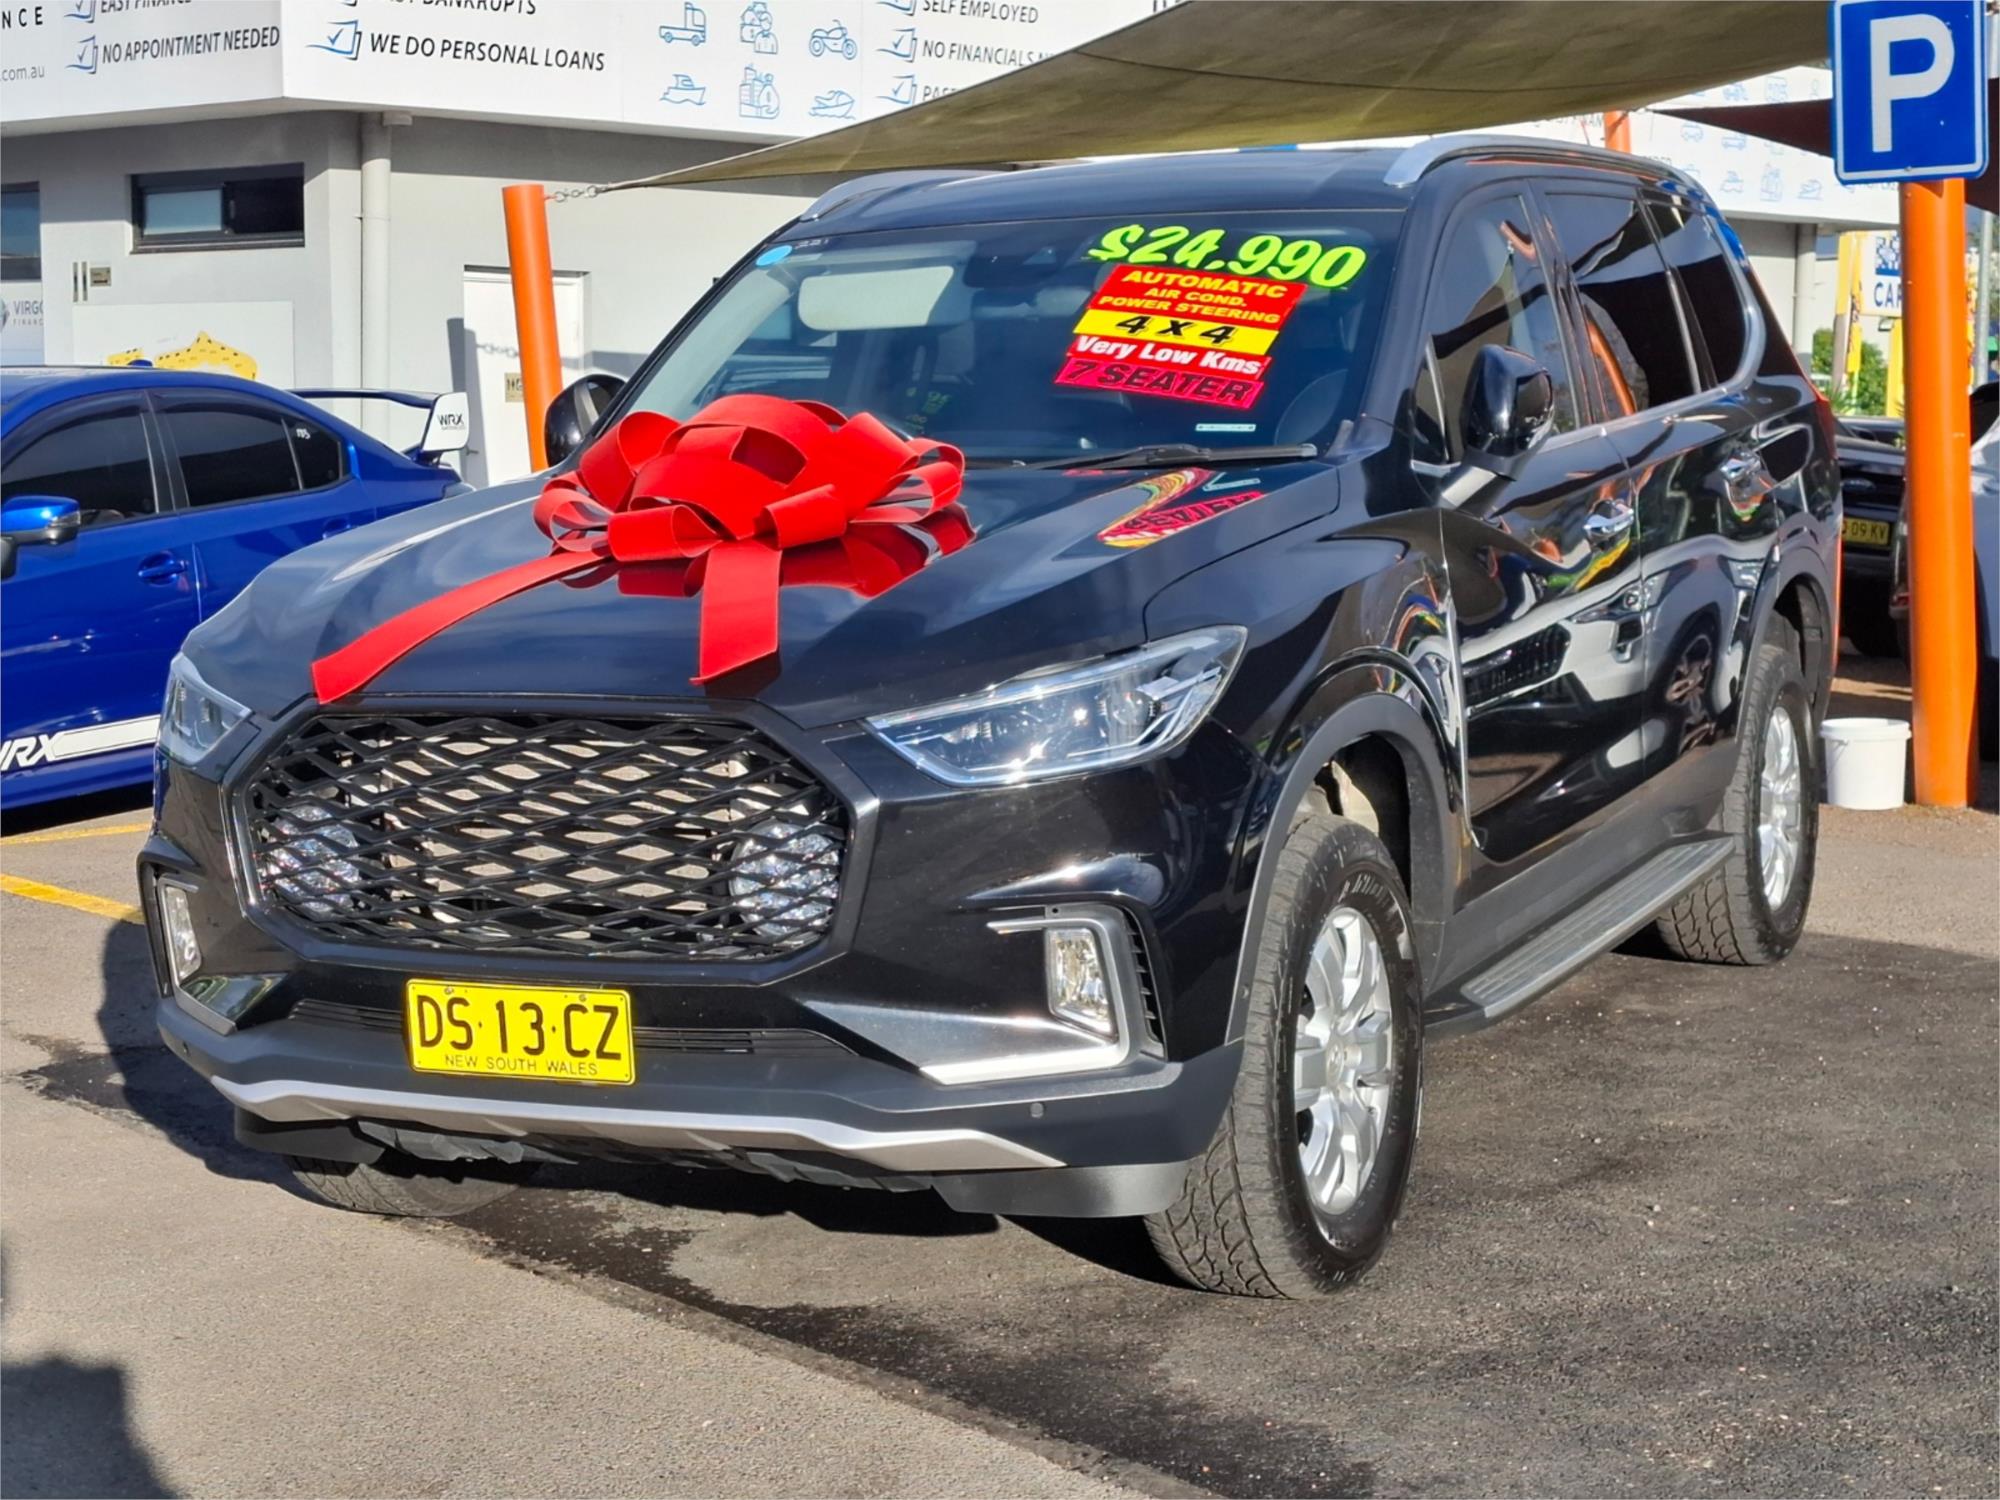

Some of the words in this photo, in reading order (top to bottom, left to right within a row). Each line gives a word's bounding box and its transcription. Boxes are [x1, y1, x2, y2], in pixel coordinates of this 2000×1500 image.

[960, 0, 1039, 24] EMPLOYED
[102, 43, 121, 64] NO
[124, 31, 221, 62] APPOINTMENT
[223, 25, 280, 52] NEEDED
[370, 32, 400, 54] WE
[405, 36, 435, 57] DO
[440, 39, 539, 66] PERSONAL
[544, 49, 605, 71] LOANS
[922, 39, 946, 59] NO
[949, 42, 1034, 67] FINANCIALS
[1870, 13, 1955, 153] P
[1122, 270, 1288, 299] AUTOMATIC
[1144, 287, 1180, 300] AIR
[1185, 291, 1247, 307] COND.
[1099, 295, 1170, 312] POWER
[1175, 302, 1281, 324] STEERING
[1076, 335, 1135, 360] Very
[1139, 344, 1196, 366] Low
[1200, 351, 1262, 376] Kms
[1067, 361, 1096, 380] 7
[1097, 364, 1252, 402] SEATER
[438, 414, 464, 426] WRX
[445, 1054, 478, 1069] NEW
[486, 1056, 537, 1072] SOUTH
[546, 1060, 598, 1076] WALES
